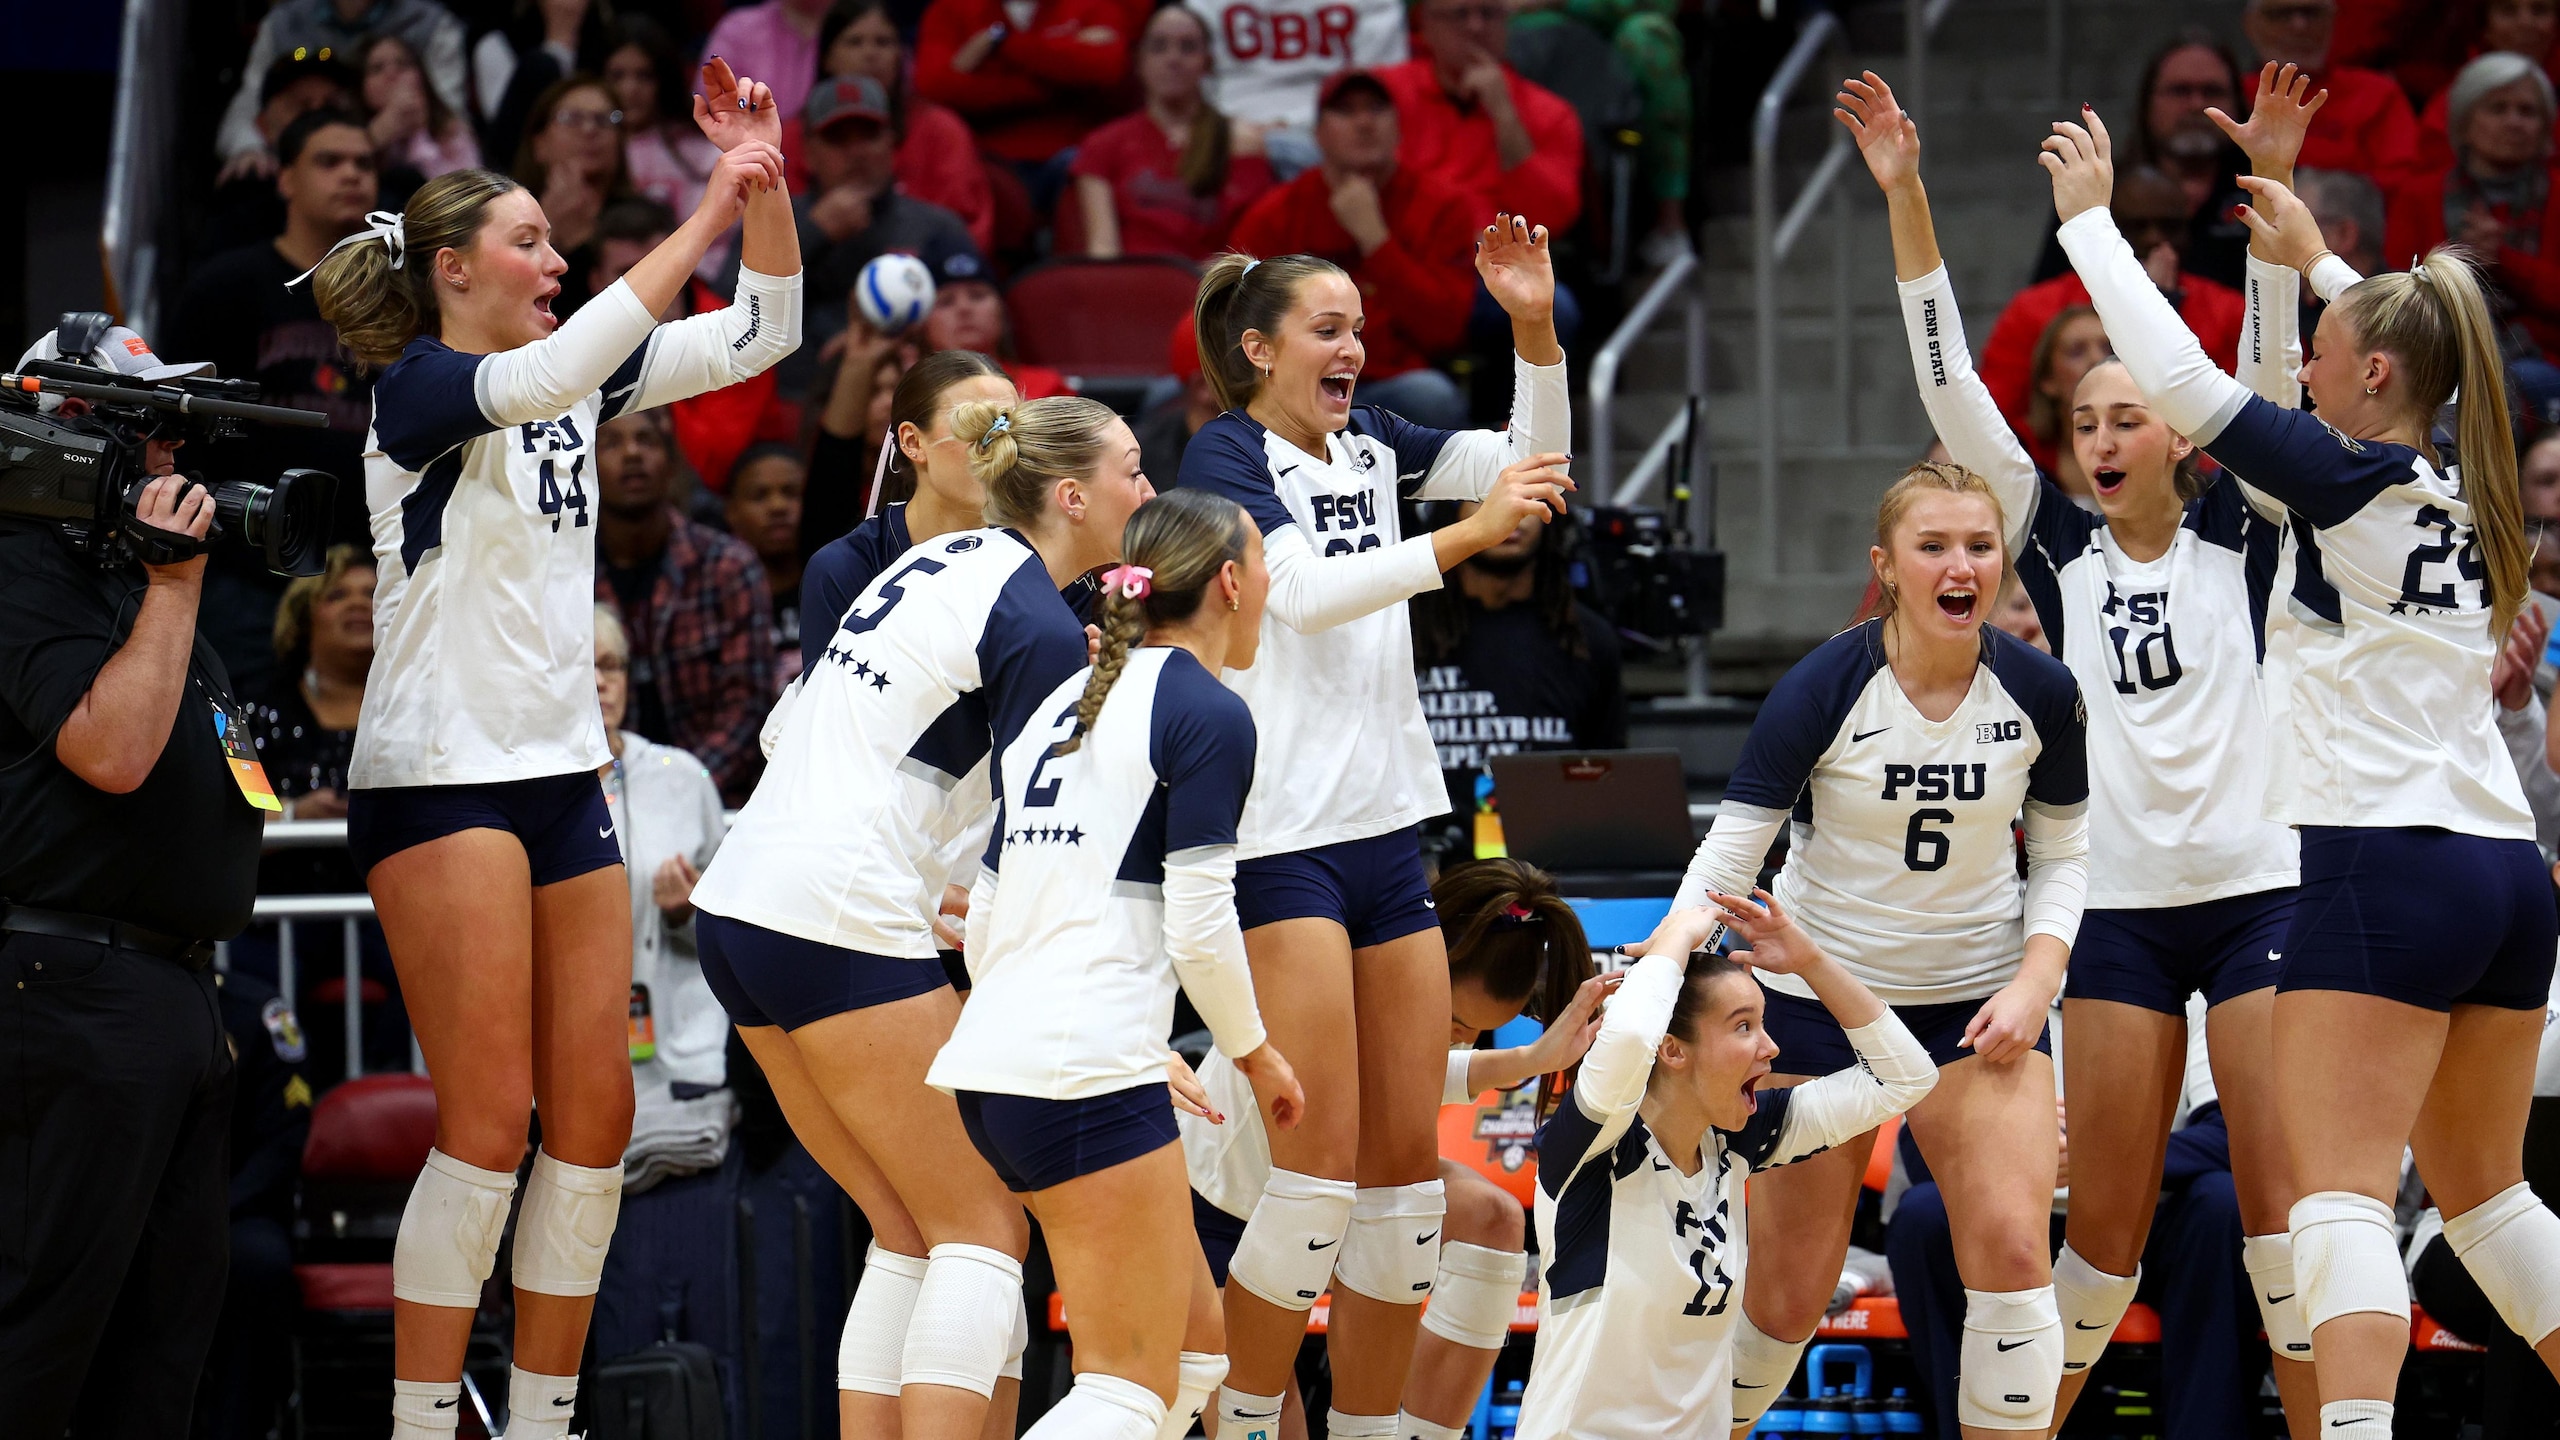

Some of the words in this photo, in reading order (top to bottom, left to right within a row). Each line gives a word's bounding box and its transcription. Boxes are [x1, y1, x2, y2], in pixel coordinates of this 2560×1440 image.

[1222, 4, 1357, 64] GBR
[1924, 298, 1938, 337] PENN
[2251, 278, 2260, 312] LIONS
[2253, 313, 2261, 364] NITTANY
[1928, 340, 1947, 387] STATE
[520, 414, 584, 454] PSU
[63, 452, 96, 465] SONY
[538, 454, 589, 533] 44
[1310, 488, 1377, 533] PSU
[841, 556, 948, 636] 5
[2108, 621, 2183, 692] 10
[1429, 716, 1574, 742] OLLEYBALL.
[1023, 700, 1085, 809] 2
[1881, 763, 1987, 801] PSU
[1904, 808, 1955, 872] 6
[1682, 1249, 1733, 1316] 11
[1832, 1310, 1870, 1330] HERE
